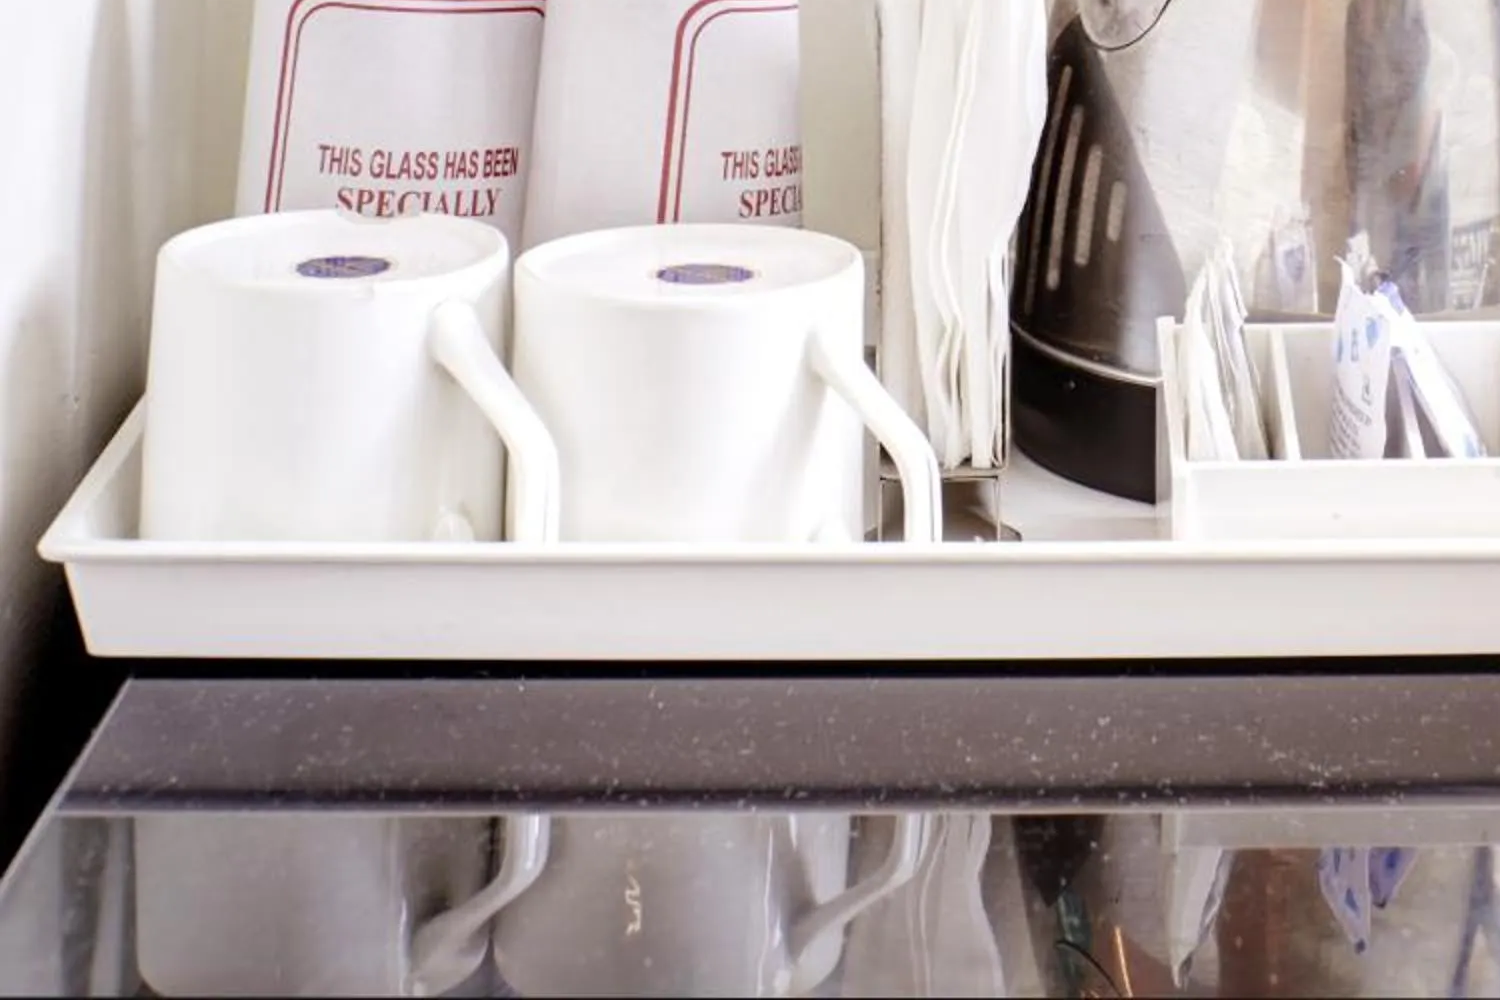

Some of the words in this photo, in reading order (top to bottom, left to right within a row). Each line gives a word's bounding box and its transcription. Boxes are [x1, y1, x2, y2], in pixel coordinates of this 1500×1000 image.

[319, 144, 362, 177] THIS
[369, 149, 439, 180] GLASS
[443, 150, 478, 180] HAS
[483, 147, 519, 178] BEEN
[720, 151, 760, 180] THIS
[336, 186, 502, 218] SPECIALLY
